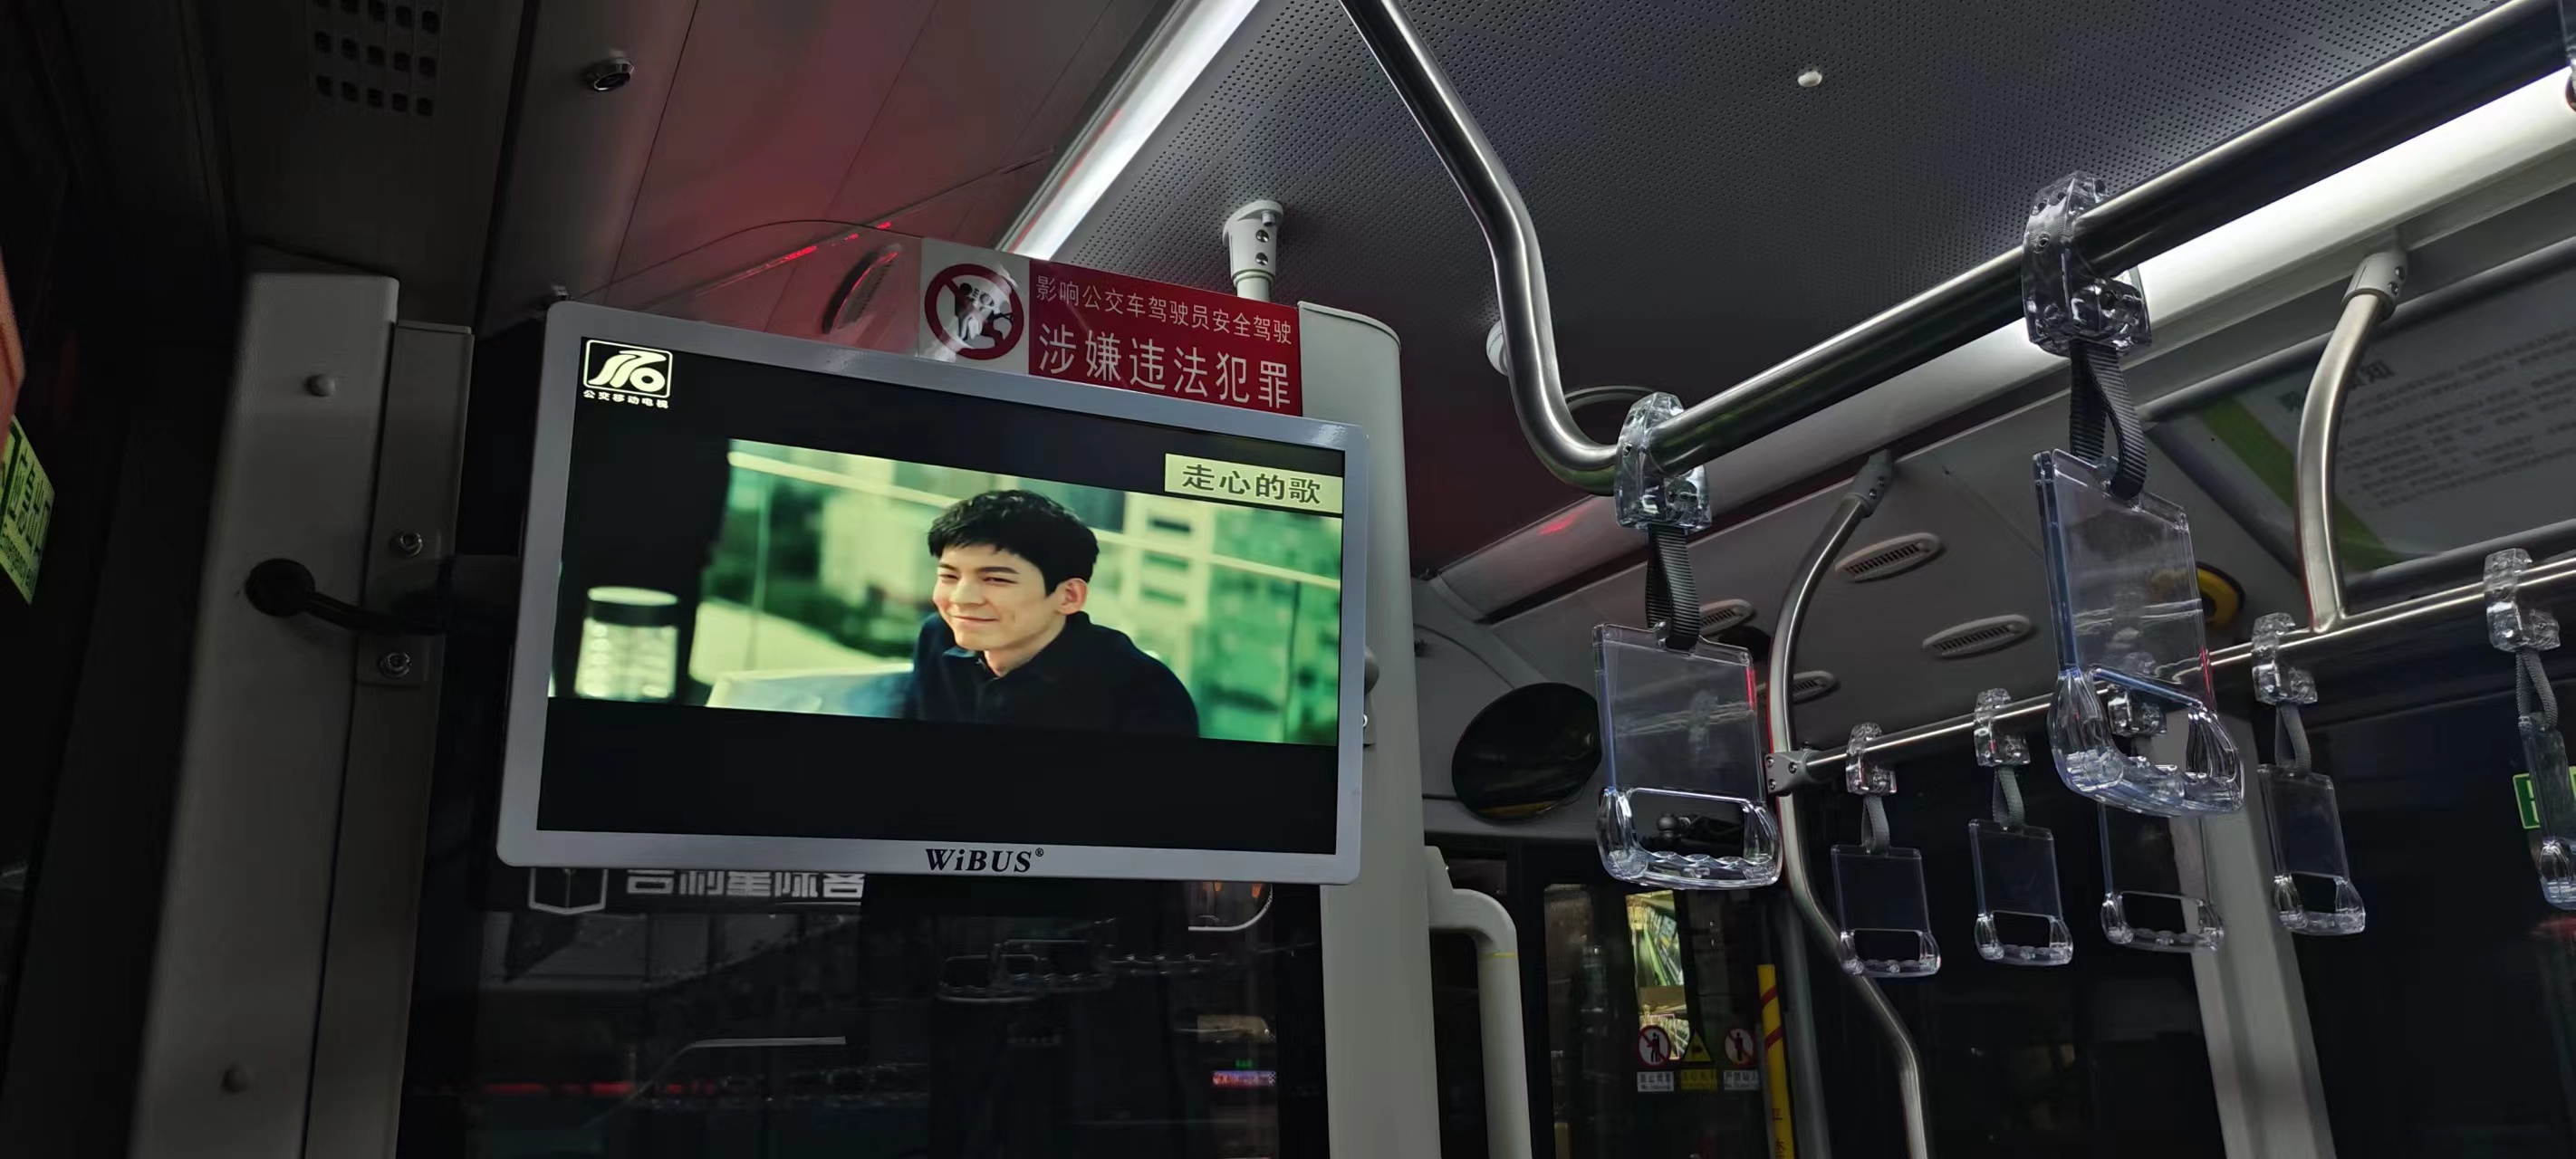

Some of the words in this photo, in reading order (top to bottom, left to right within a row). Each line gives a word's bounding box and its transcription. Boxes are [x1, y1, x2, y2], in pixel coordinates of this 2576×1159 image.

[1035, 275, 1293, 345] 影响公交车驾驶员安全驾驶
[1038, 322, 1292, 409] 涉嫌违法犯罪
[1181, 464, 1322, 504] 走心的歌
